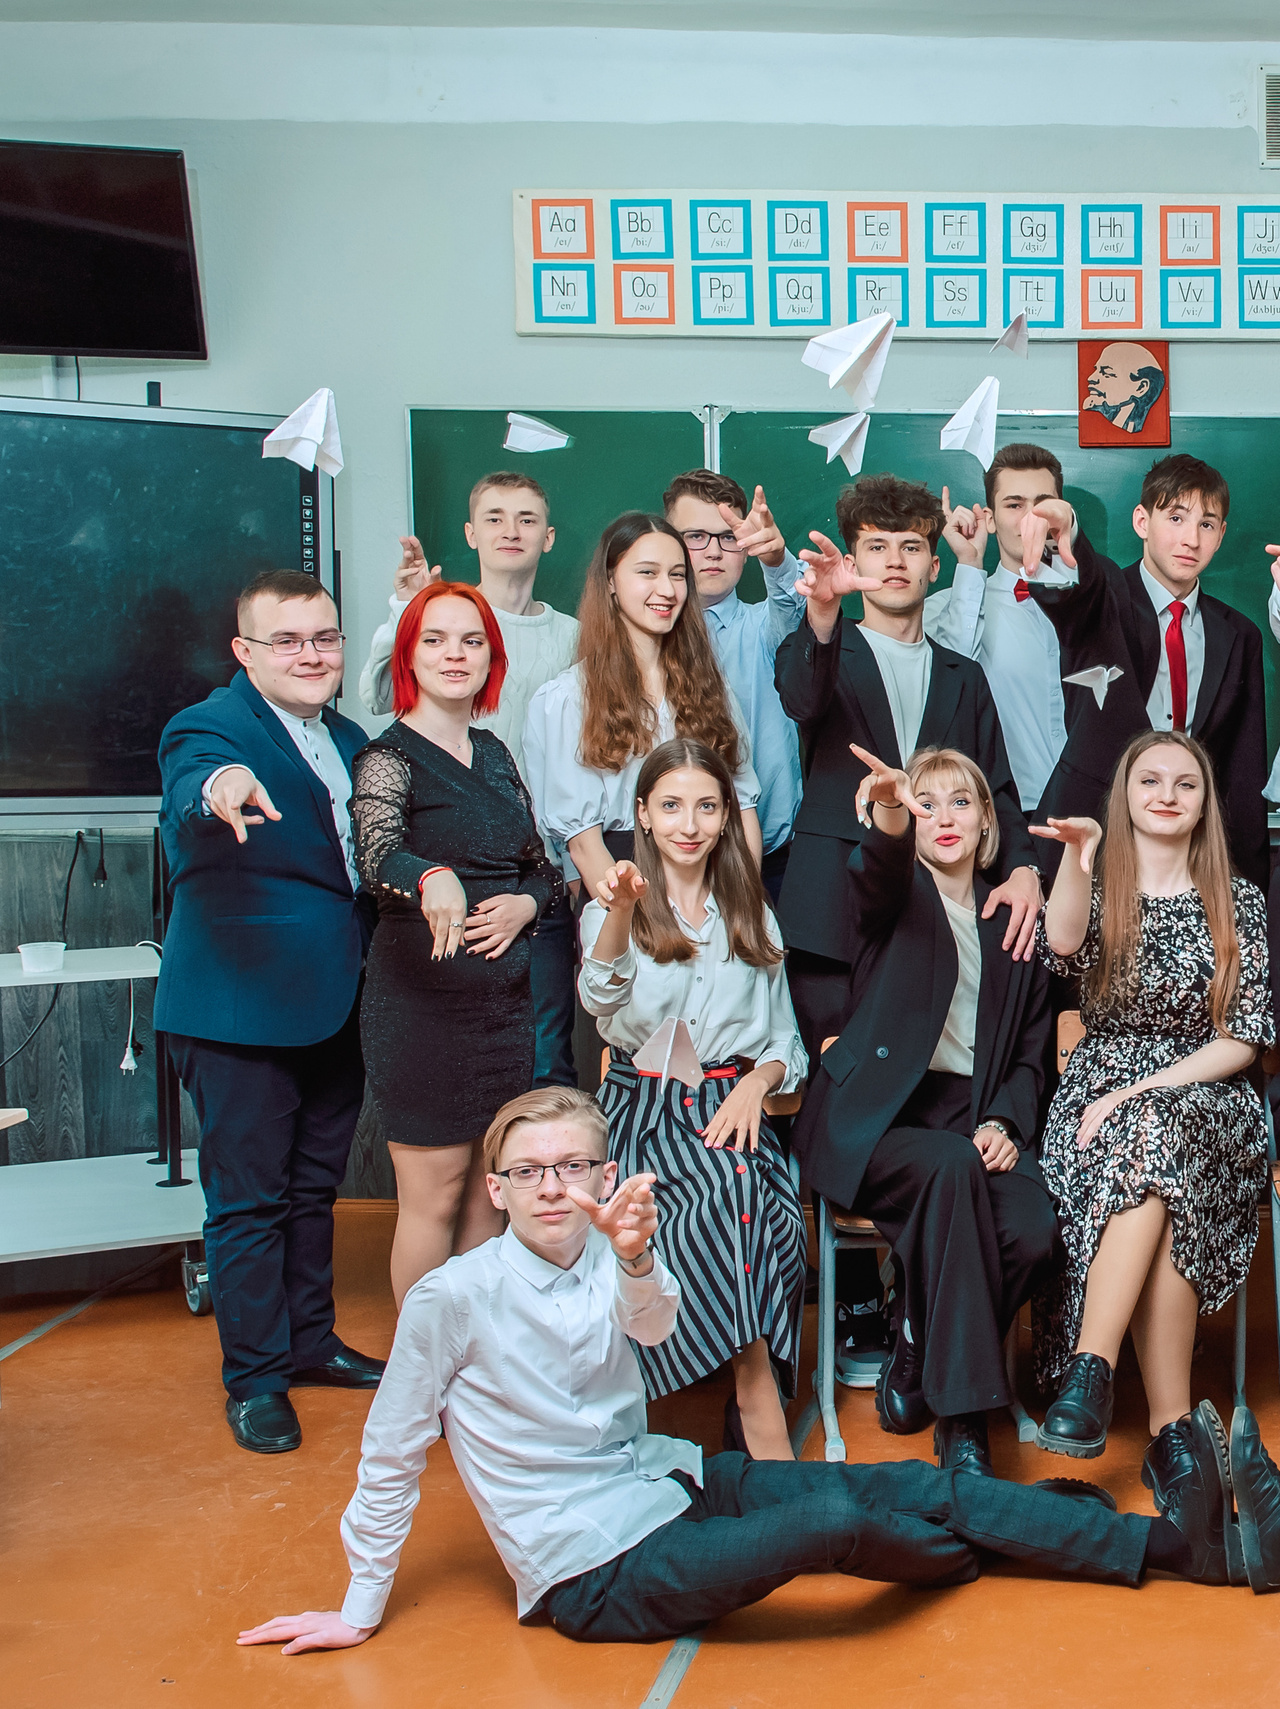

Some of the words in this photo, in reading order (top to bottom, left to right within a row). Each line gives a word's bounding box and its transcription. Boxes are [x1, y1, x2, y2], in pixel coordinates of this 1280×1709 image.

[549, 211, 576, 233] Aa
[627, 211, 652, 233] Bb
[708, 212, 732, 233] Cc
[785, 213, 812, 234] Dd
[864, 215, 889, 236] Ee
[943, 214, 968, 235] Ff
[1020, 216, 1046, 242] Gg
[1098, 217, 1123, 238] Hh
[1257, 218, 1275, 243] Jj
[946, 241, 965, 251] /ef/
[551, 275, 576, 297] Nn
[632, 276, 657, 298] Oo
[709, 277, 733, 302] Pp
[786, 279, 813, 302] Qq
[865, 280, 887, 301] Rr
[944, 280, 968, 301] Ss
[1020, 280, 1044, 302] Tt
[1099, 281, 1126, 302] Uu
[1178, 282, 1202, 302] Vv
[556, 302, 576, 311] /en/
[947, 306, 965, 316] /es/
